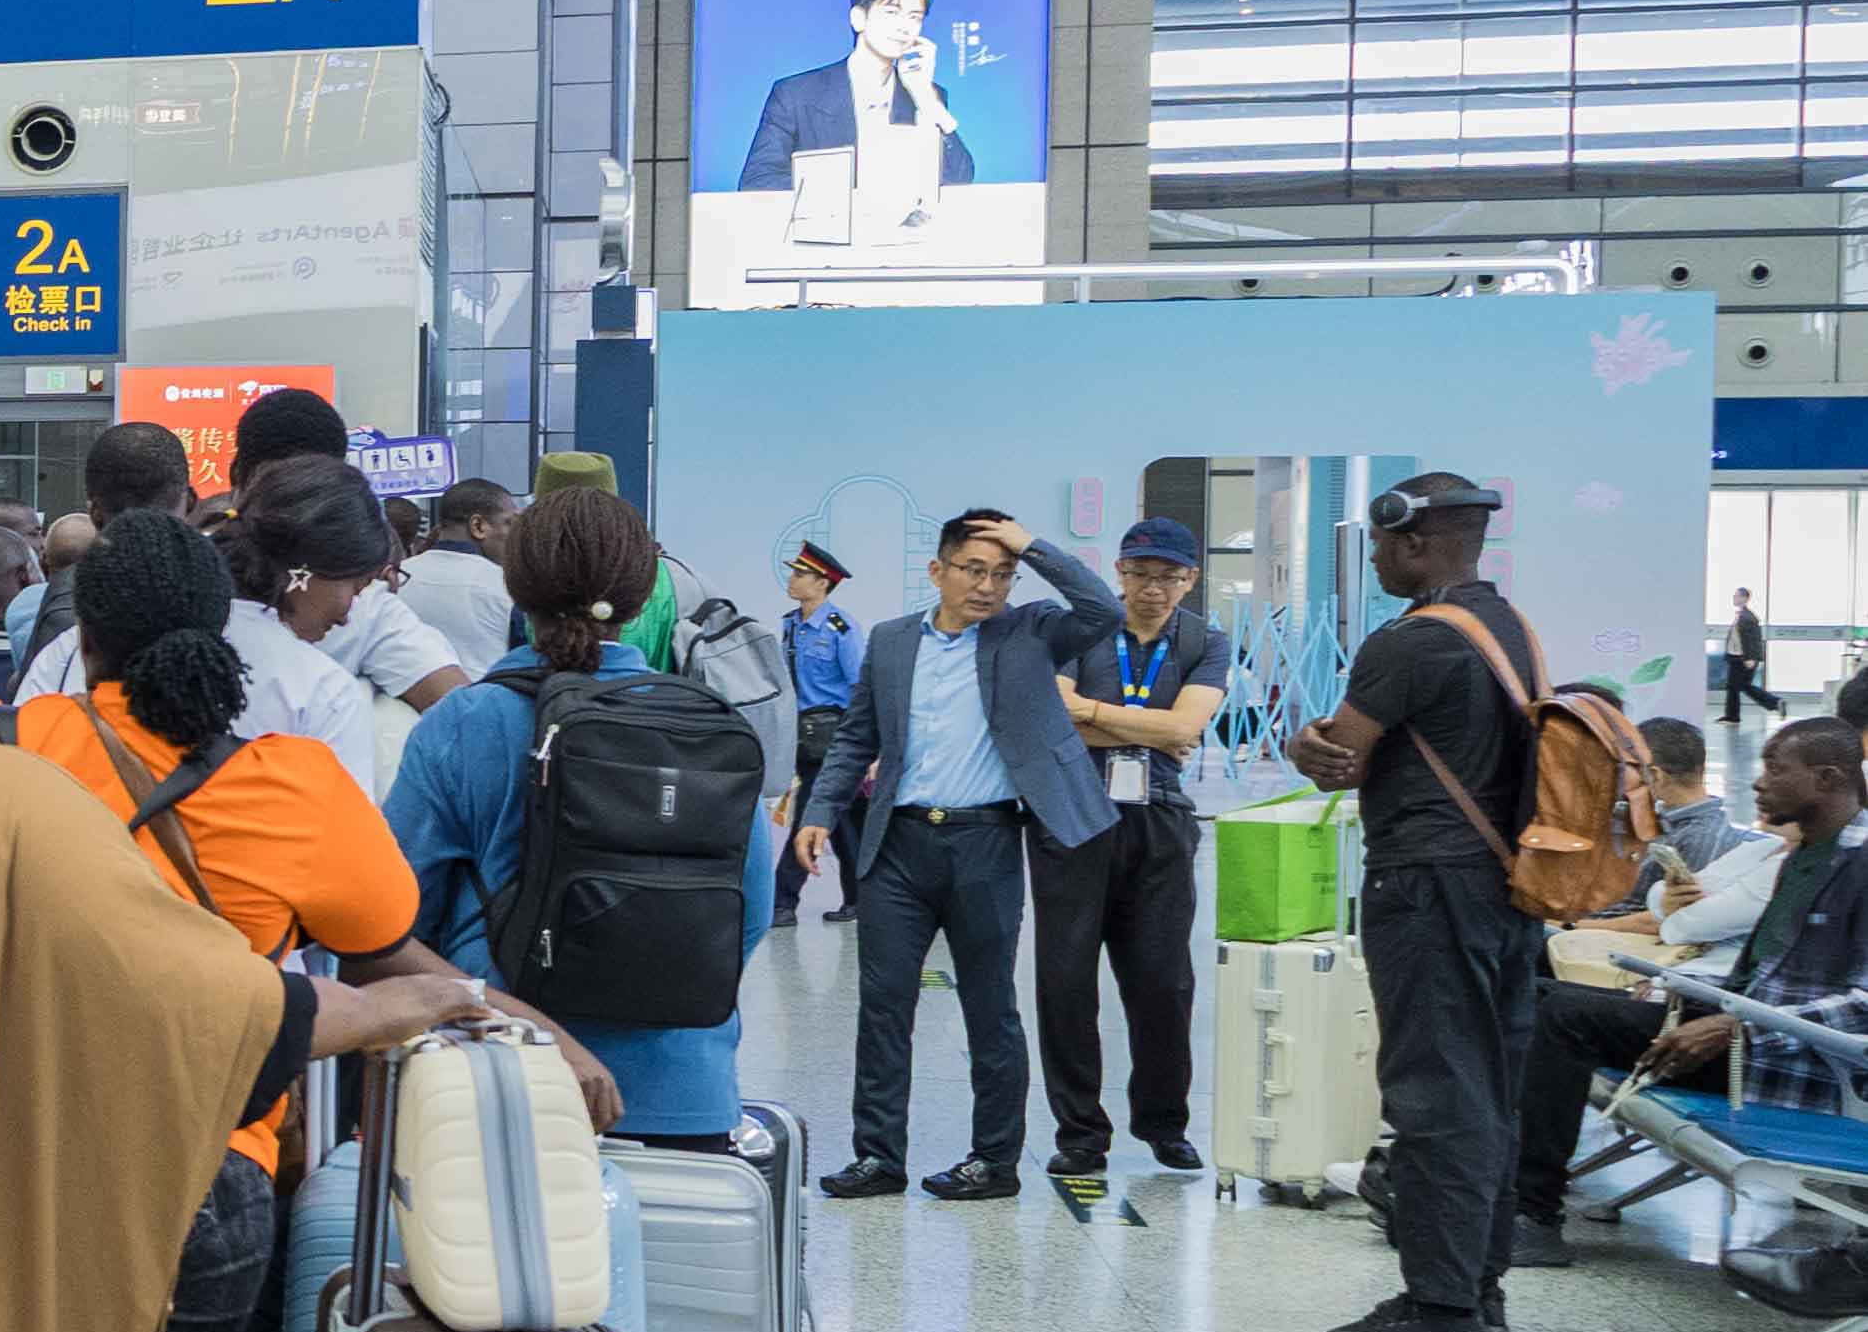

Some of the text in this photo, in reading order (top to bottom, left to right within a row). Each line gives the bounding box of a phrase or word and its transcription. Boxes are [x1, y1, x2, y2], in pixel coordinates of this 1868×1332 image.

[14, 219, 90, 275] 2A
[5, 285, 102, 315] 检票口
[12, 316, 90, 334] Check in
